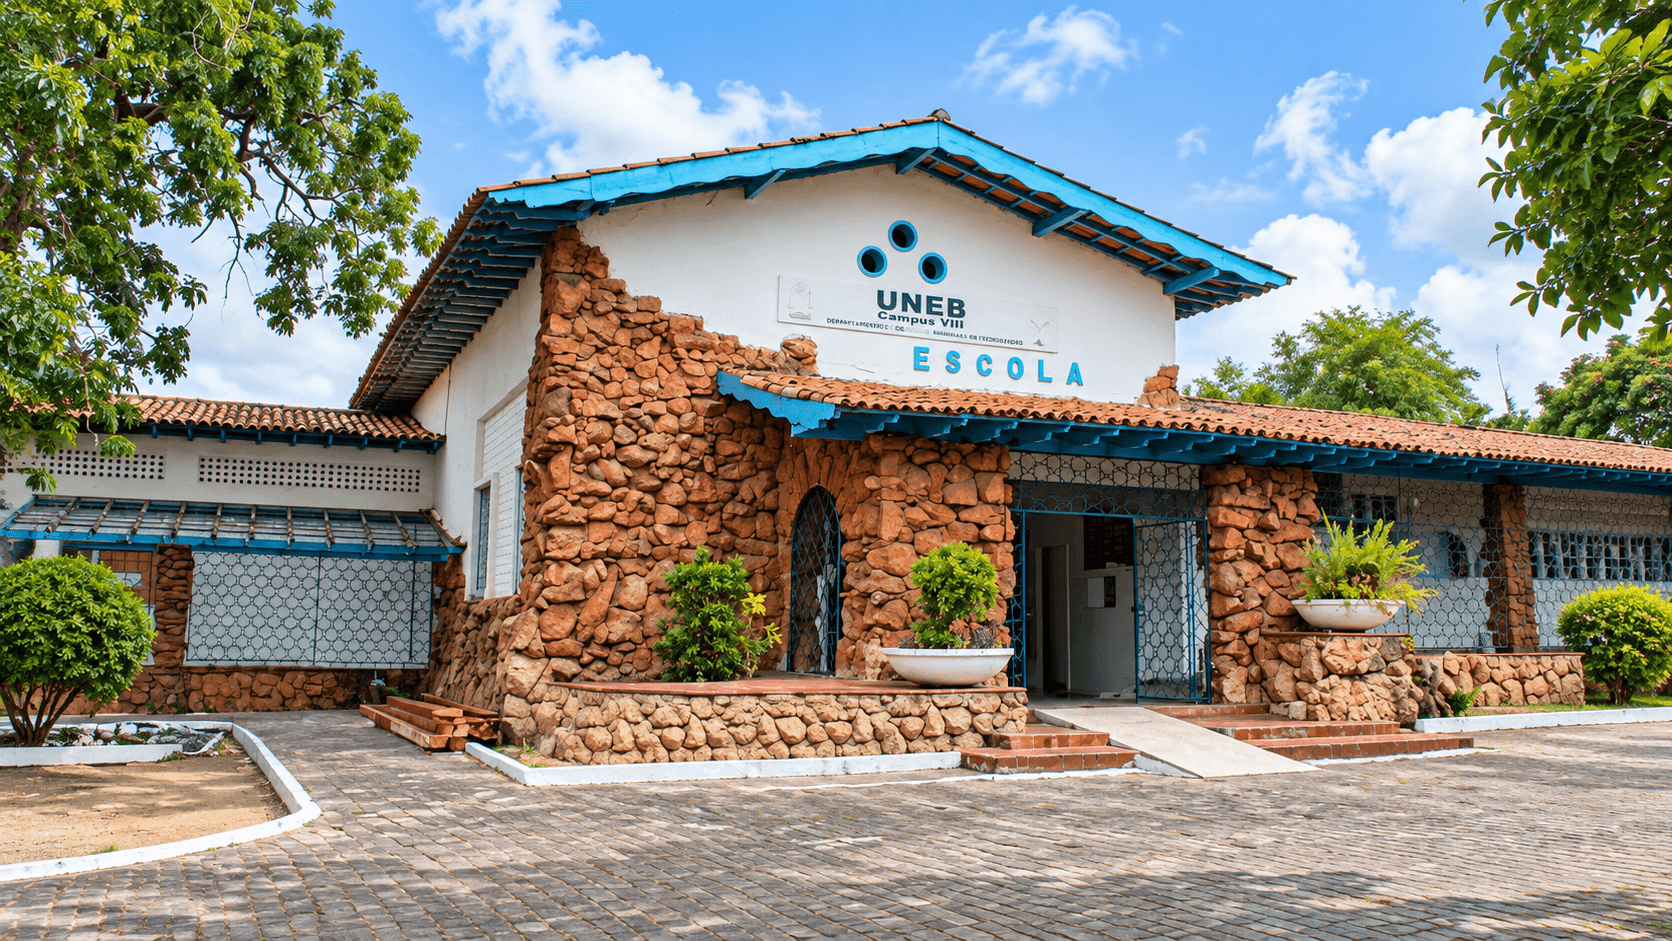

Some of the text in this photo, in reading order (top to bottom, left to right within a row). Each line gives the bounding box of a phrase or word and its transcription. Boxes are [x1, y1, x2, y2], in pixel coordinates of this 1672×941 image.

[877, 289, 966, 318] UNEB
[878, 311, 964, 329] Campus VIII
[913, 346, 1084, 386] ESCOLA
